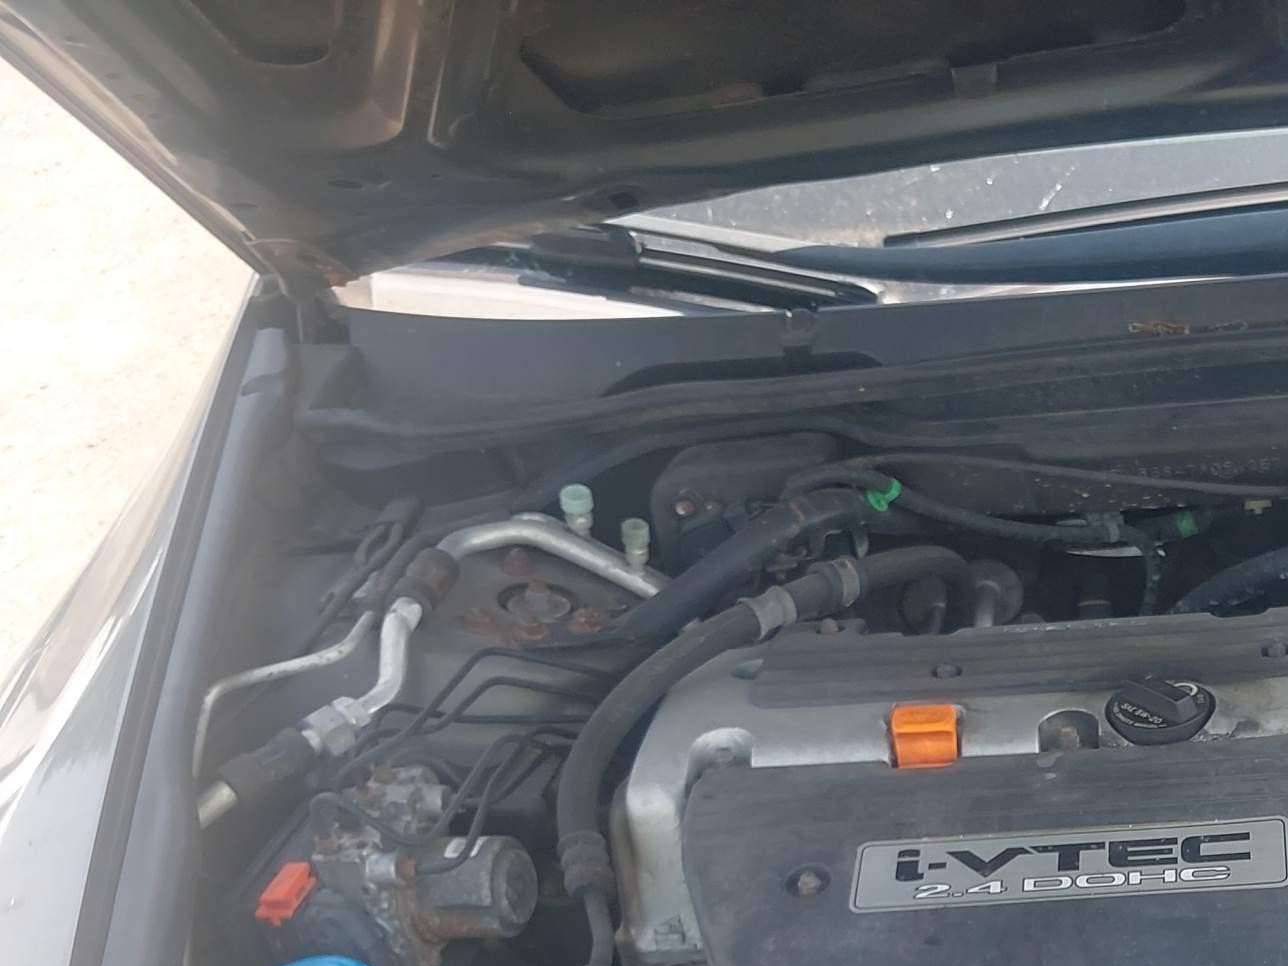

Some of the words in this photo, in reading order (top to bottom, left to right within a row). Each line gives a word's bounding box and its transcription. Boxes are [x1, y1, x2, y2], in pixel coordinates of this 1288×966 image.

[895, 831, 1251, 883] i-VTEC
[913, 880, 1008, 900] 2.4
[1021, 866, 1231, 894] DOHC
